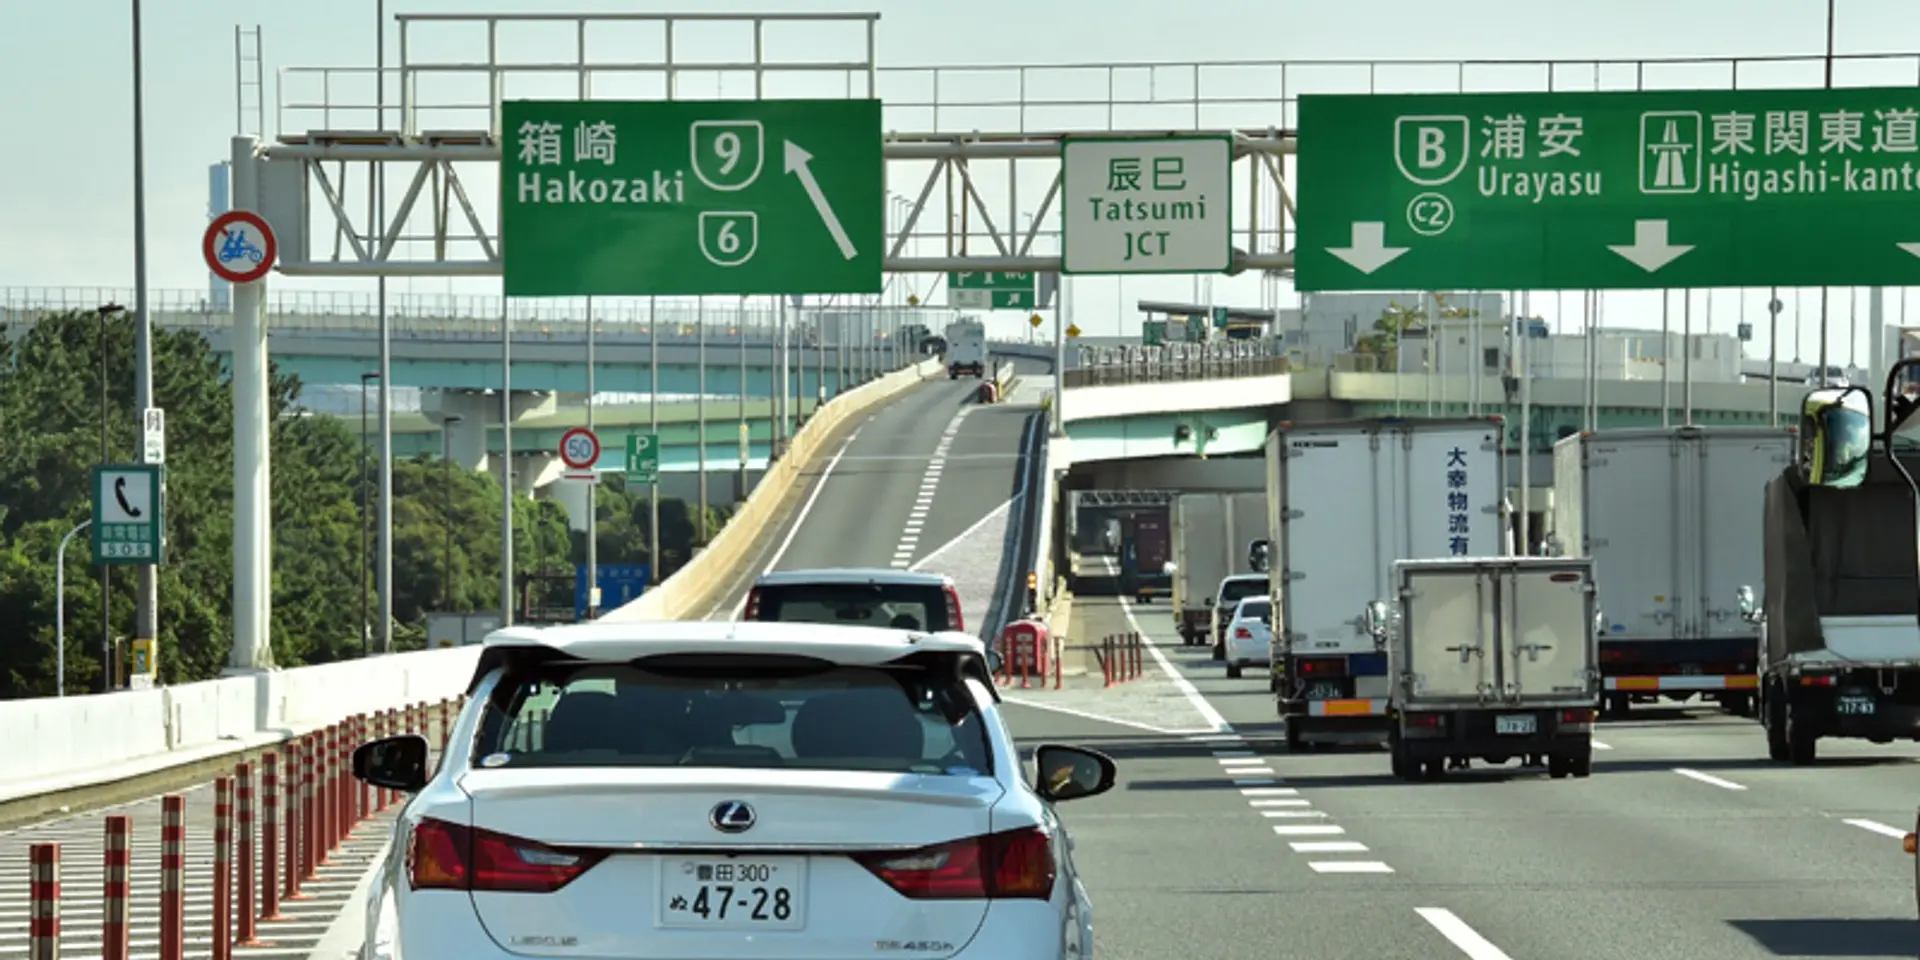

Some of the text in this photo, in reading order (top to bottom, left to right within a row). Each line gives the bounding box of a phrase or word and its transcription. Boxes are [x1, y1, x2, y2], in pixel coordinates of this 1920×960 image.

[517, 120, 617, 166] 箱崎
[1417, 127, 1447, 169] B
[1480, 113, 1584, 160] 浦安
[1710, 108, 1919, 156] 東関東道
[713, 131, 741, 176] 9
[517, 170, 685, 204] Hakozaki
[1106, 156, 1188, 191] 辰巳
[1478, 165, 1602, 203] Urayasu
[1089, 195, 1207, 221] Tatsumi
[1413, 200, 1445, 227] C2
[716, 220, 741, 254] 6
[1123, 231, 1170, 261] JCT
[568, 439, 592, 459] 50
[636, 436, 650, 455] P
[1446, 446, 1471, 556] 大幸物流有
[107, 542, 145, 556] SOS
[696, 864, 769, 882] 豊田 300
[669, 886, 792, 920] ぬ 47-28
